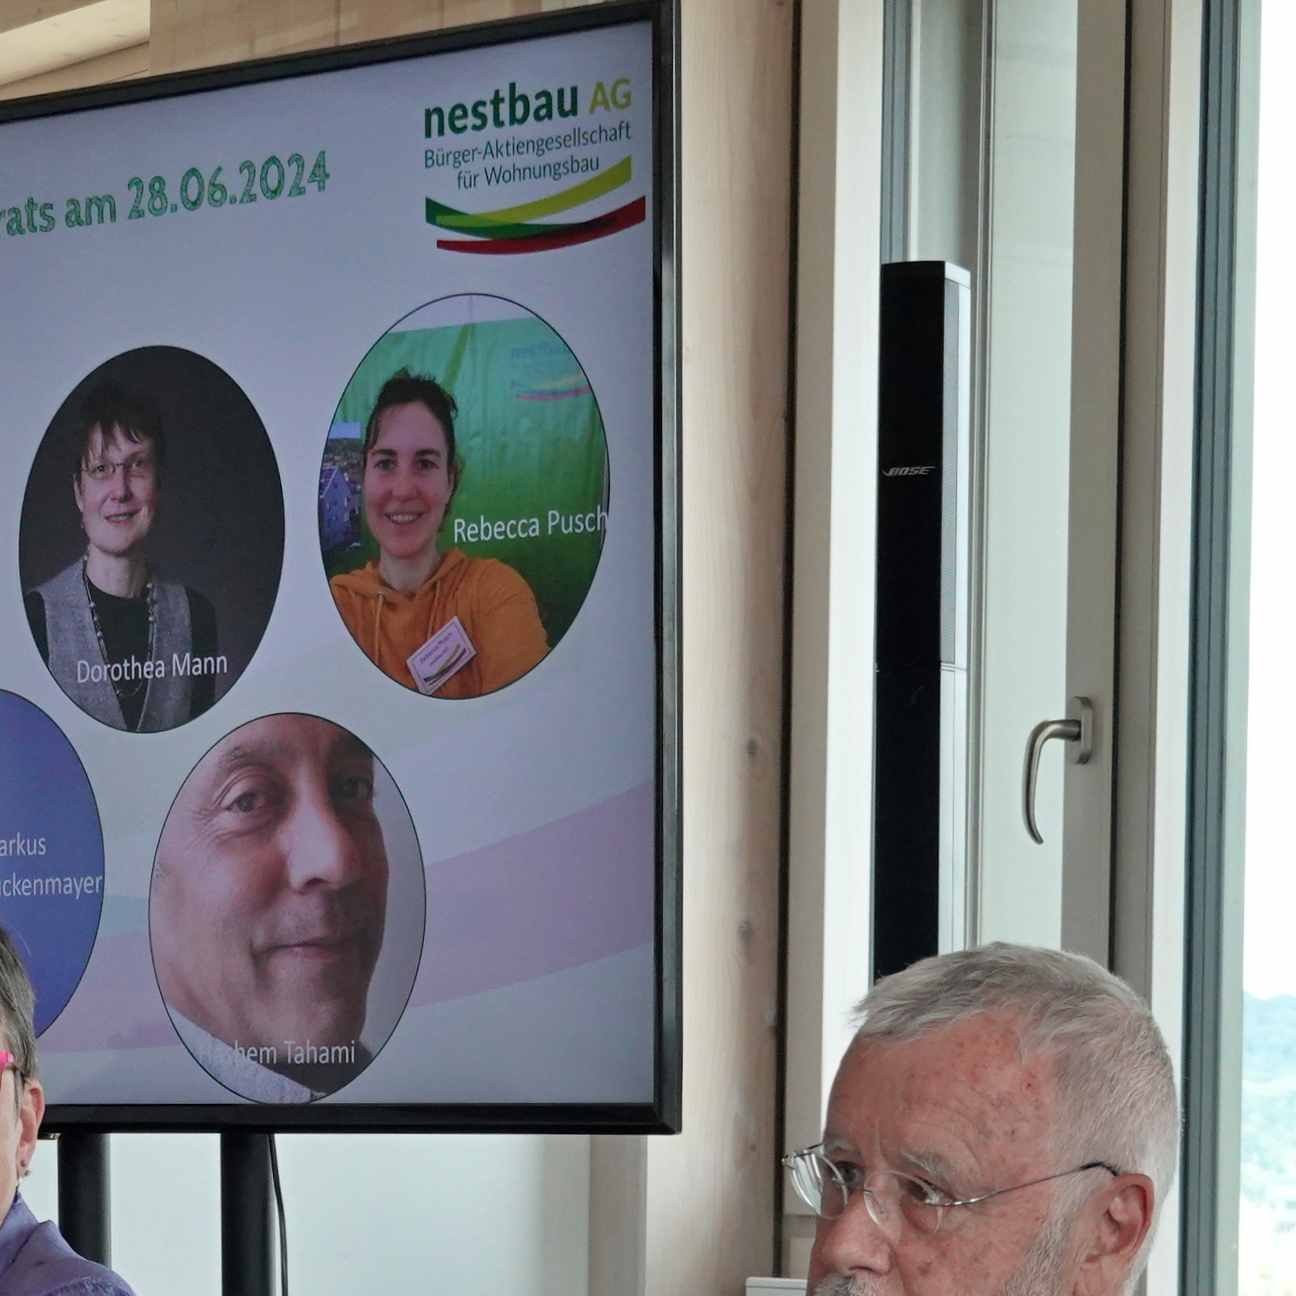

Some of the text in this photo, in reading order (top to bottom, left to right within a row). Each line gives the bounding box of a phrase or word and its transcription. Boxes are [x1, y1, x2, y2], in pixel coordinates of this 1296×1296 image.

[424, 77, 633, 139] nestbau AG
[424, 120, 632, 169] Bürger-Aktiengesellschaft
[64, 193, 117, 229] am
[127, 150, 331, 220] 28.06.2024
[456, 155, 600, 190] für Wohnungsbau
[882, 465, 936, 477] BOSE
[454, 504, 609, 544] Rebecca Pusch
[77, 652, 228, 684] Dorothea Mann
[283, 1040, 355, 1065] Tahami
